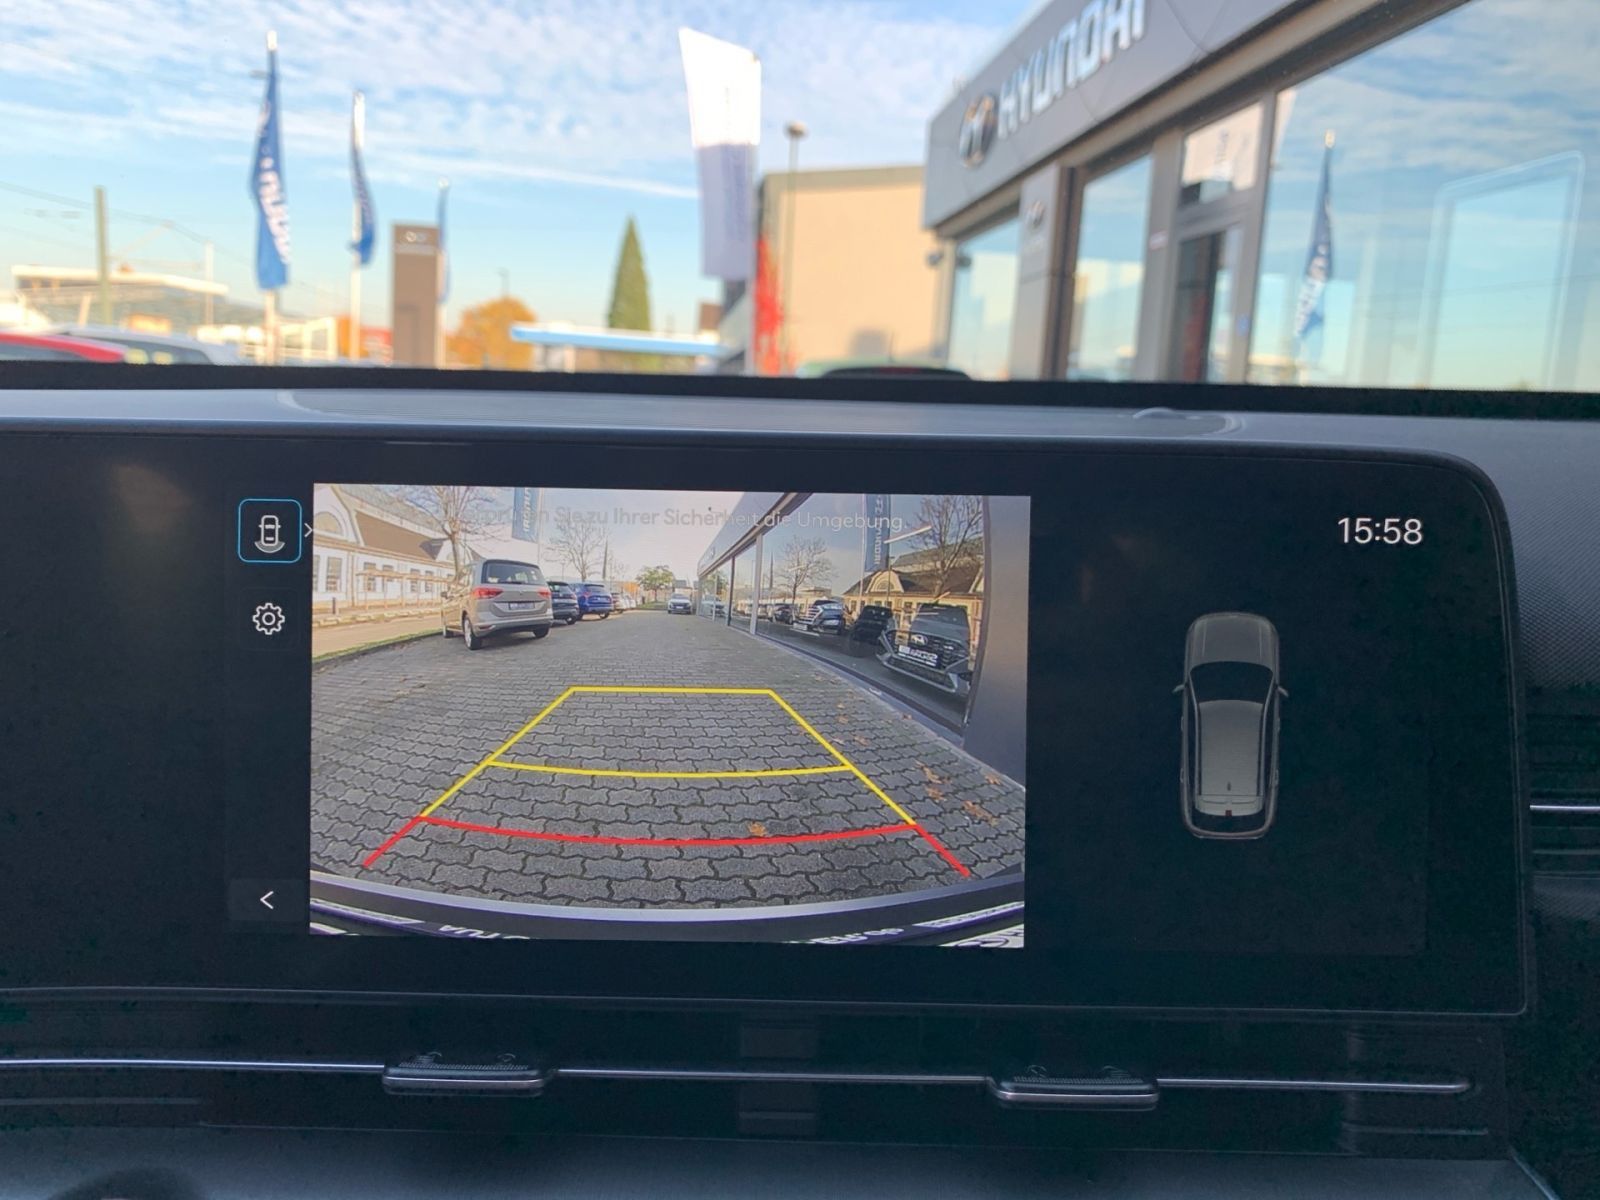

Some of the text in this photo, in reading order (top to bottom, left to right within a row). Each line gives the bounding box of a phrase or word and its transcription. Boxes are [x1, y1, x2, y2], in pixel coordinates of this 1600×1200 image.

[998, 0, 1145, 140] HYUNDAI
[553, 506, 582, 523] Sie
[586, 510, 608, 523] zu
[613, 507, 660, 525] Ihrer
[663, 508, 760, 527] Sicherheit
[764, 511, 790, 528] die
[798, 511, 908, 533] Umgebung.
[1338, 517, 1423, 545] 15:58
